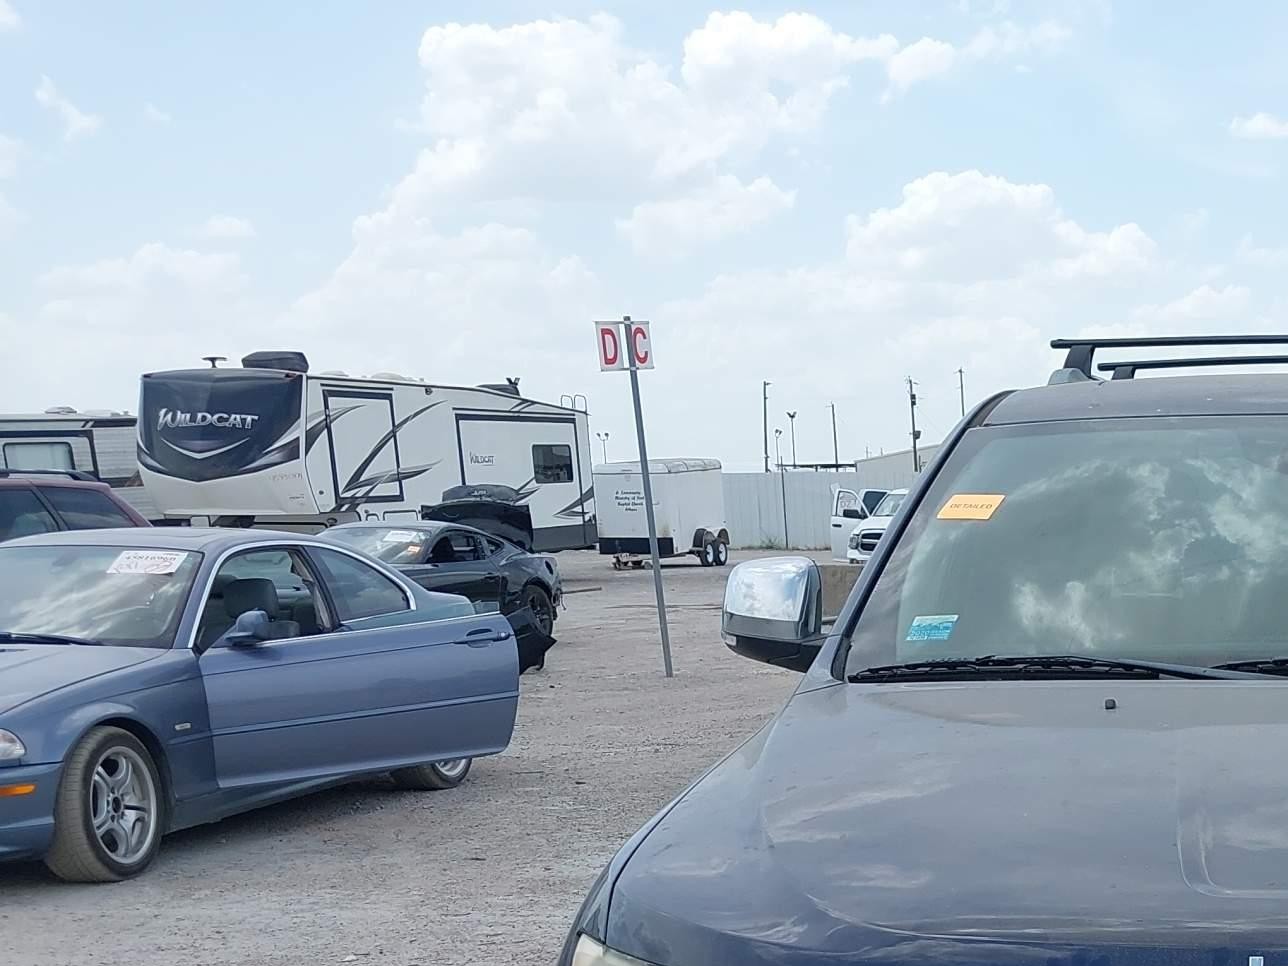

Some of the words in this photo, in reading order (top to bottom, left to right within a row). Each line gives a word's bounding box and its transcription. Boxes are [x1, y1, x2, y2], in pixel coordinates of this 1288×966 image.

[600, 328, 618, 365] D
[632, 327, 648, 364] C
[157, 408, 259, 431] WILDCAT
